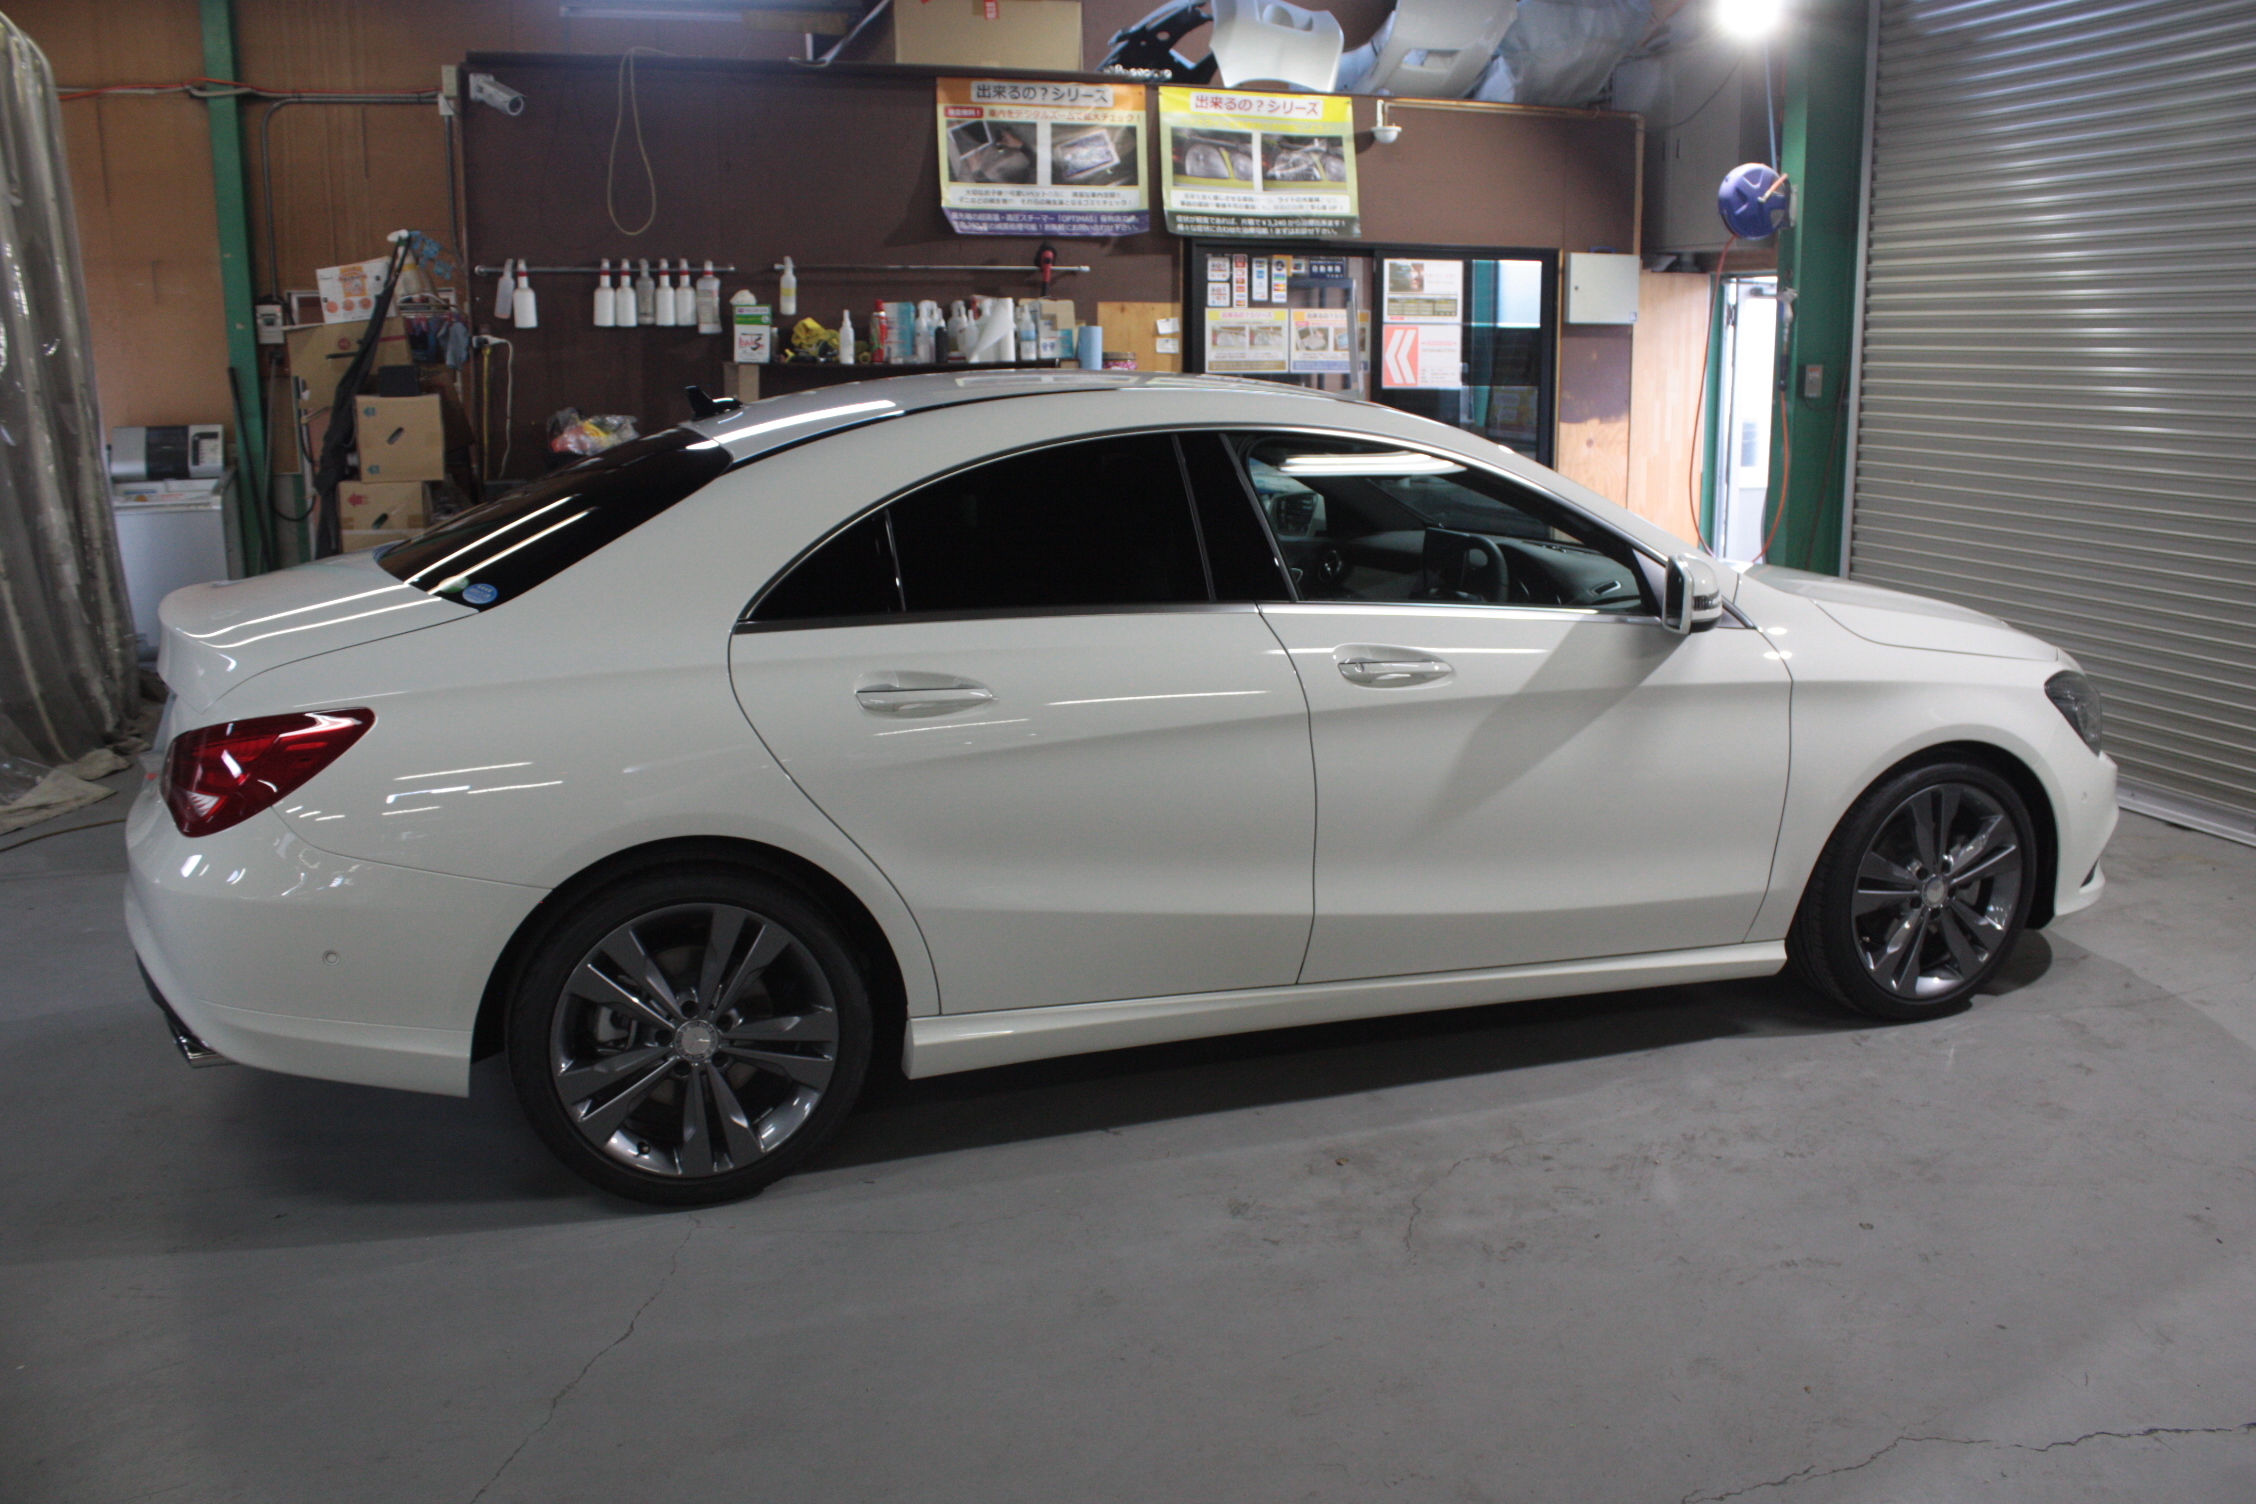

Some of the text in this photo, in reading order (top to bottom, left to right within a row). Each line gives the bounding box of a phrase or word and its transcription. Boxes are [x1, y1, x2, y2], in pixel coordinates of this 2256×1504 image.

[976, 84, 1108, 103] 出来るの？シリーズ
[1195, 95, 1319, 116] 出来るの？シリーズ
